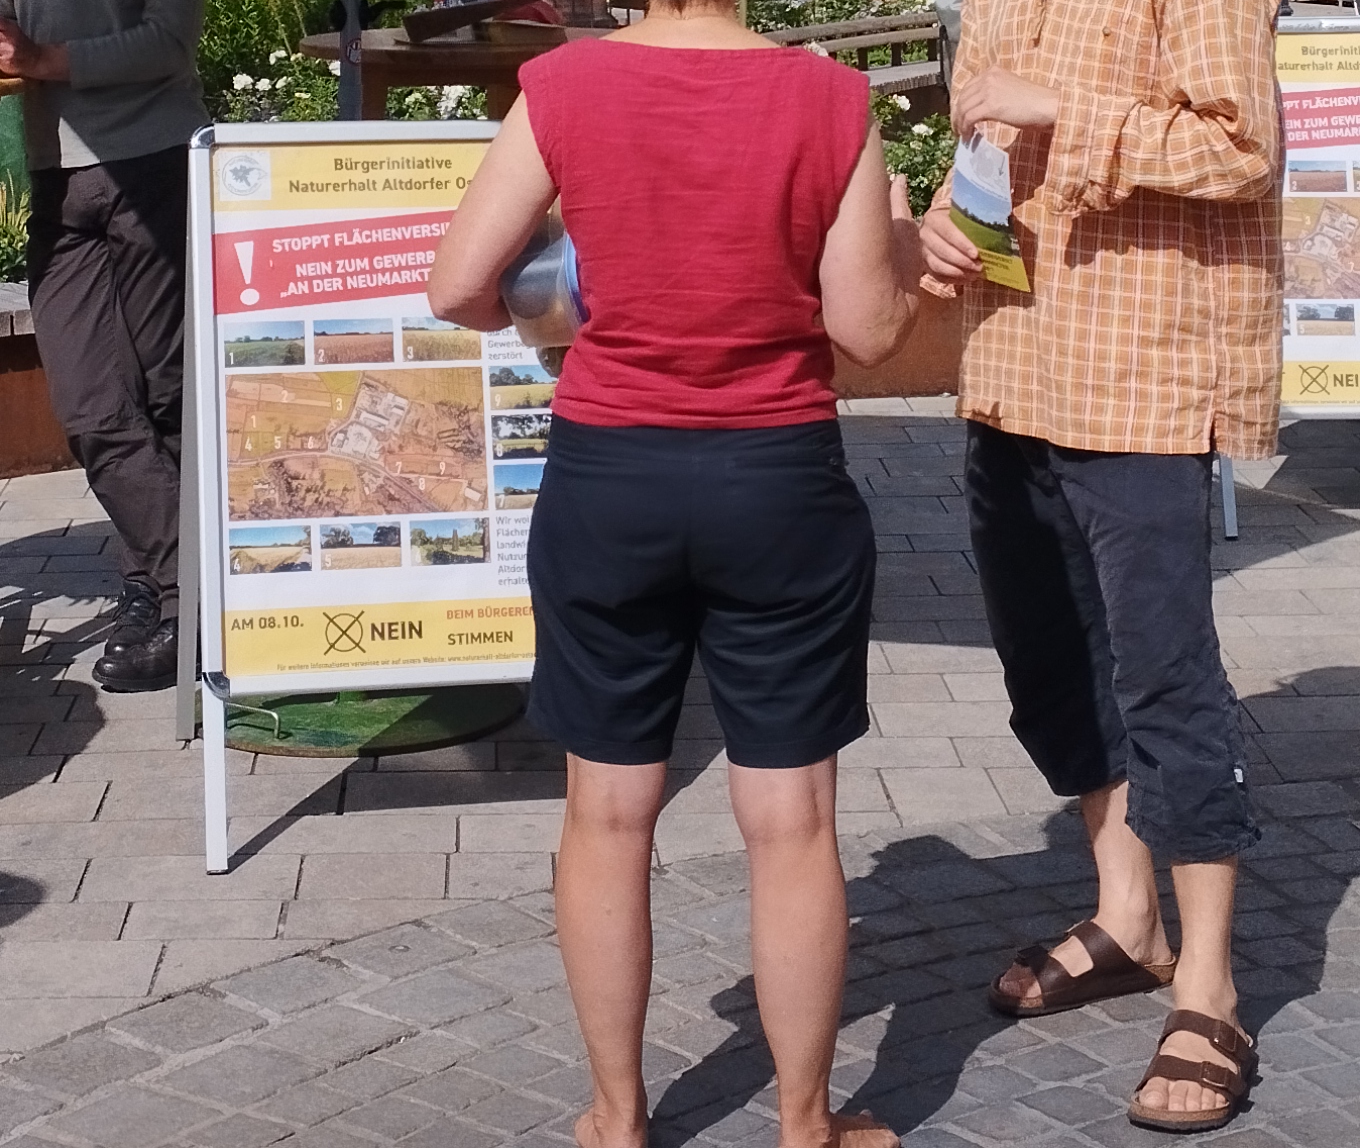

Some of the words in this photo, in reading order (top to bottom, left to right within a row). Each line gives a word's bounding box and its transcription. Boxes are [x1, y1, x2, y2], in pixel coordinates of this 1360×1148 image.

[1278, 60, 1333, 71] aturerhalt
[1285, 119, 1301, 130] EIN
[1303, 117, 1328, 129] ZUM
[1287, 130, 1309, 142] DER
[334, 158, 452, 173] Bürgerinitiative
[288, 177, 378, 194] Naturerhalt
[382, 177, 451, 192] Altdorfer
[272, 233, 331, 253] STOPPT
[295, 260, 332, 278] NEIN
[336, 257, 369, 274] ZUM
[373, 251, 436, 270] GEWERB
[313, 277, 344, 294] DER
[346, 267, 430, 290] NEUMARKT
[229, 352, 234, 365] 1
[318, 349, 324, 363] 2
[336, 398, 343, 411] 3
[245, 436, 252, 451] 4
[274, 436, 281, 449] 5
[307, 436, 314, 449] 6
[395, 461, 402, 474] 7
[439, 461, 446, 475] 9
[497, 540, 527, 550] landwi
[325, 554, 332, 567] 5
[498, 565, 526, 574] Altdor
[231, 617, 254, 631] AM
[258, 615, 304, 629] 08.10.
[370, 620, 423, 641] NEIN
[446, 609, 474, 620] BEIM
[447, 630, 514, 646] STIMMEN
